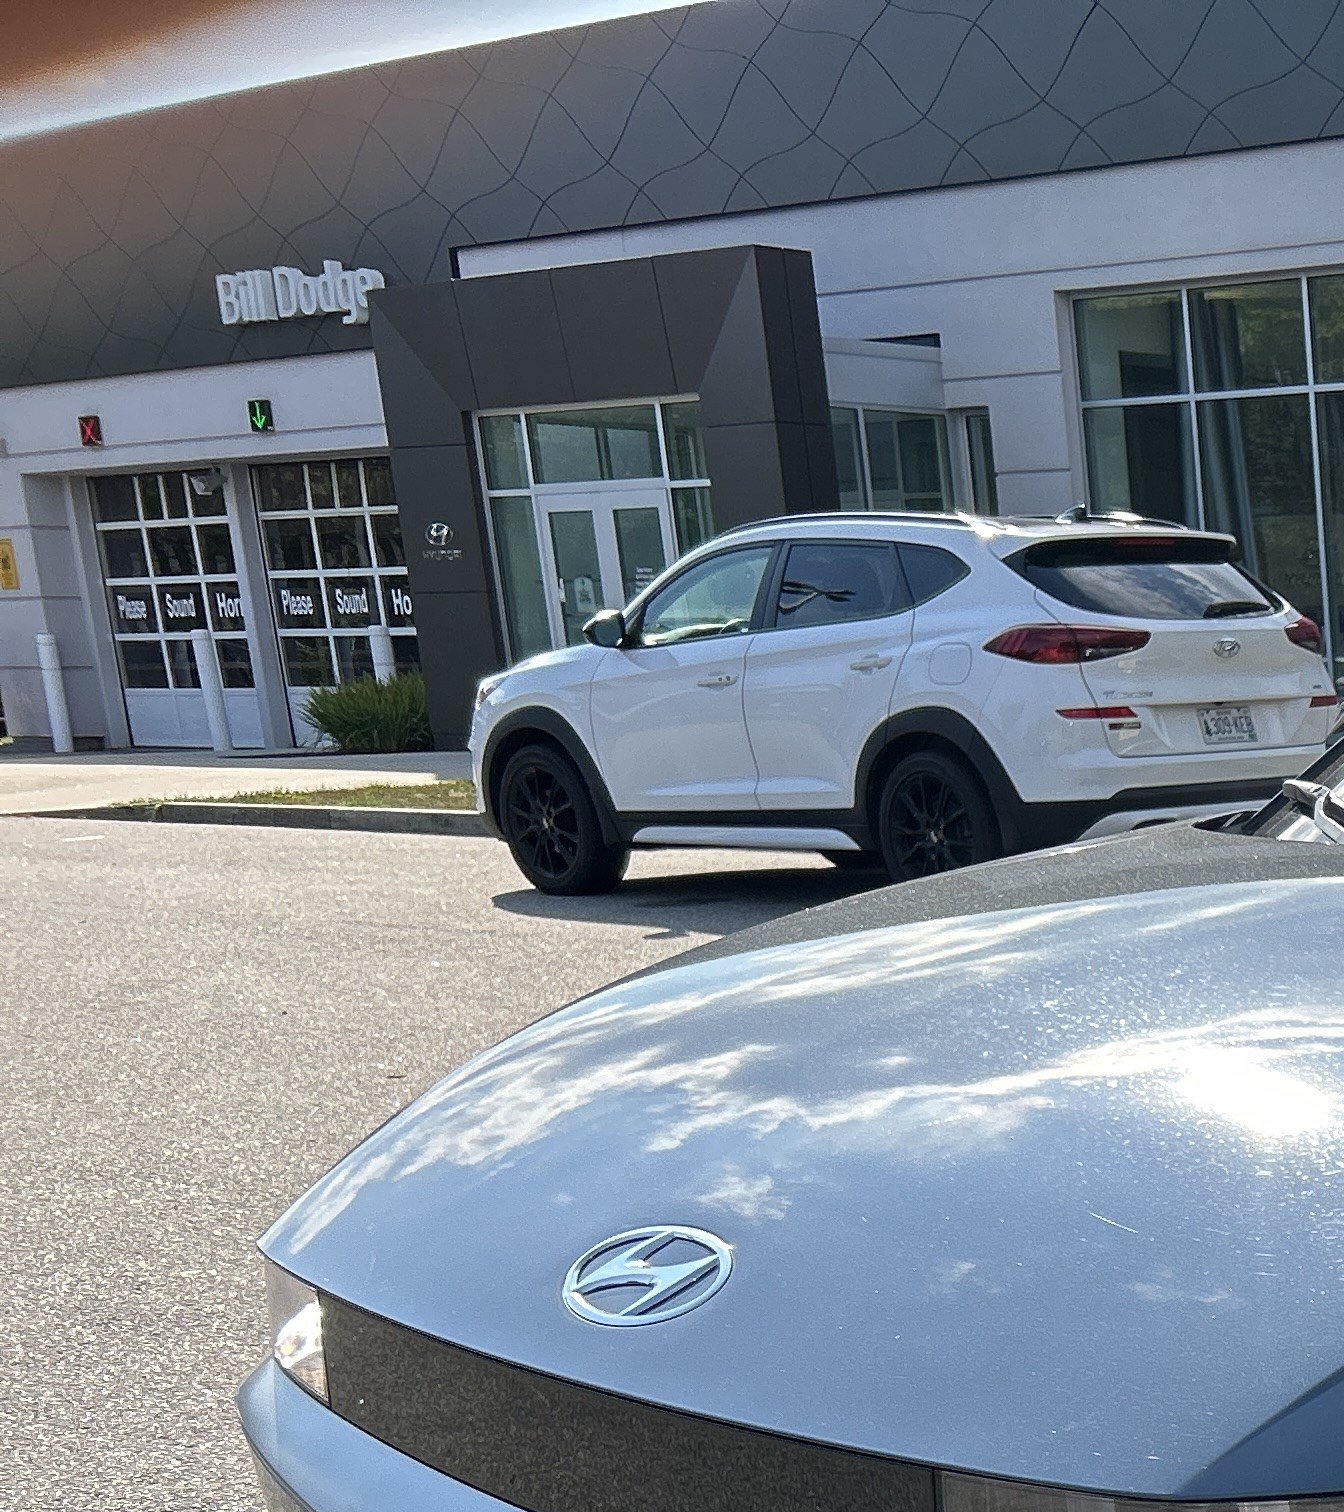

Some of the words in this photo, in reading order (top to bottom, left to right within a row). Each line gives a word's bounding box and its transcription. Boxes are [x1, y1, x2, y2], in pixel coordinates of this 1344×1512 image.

[215, 269, 279, 325] Bill
[272, 260, 384, 324] Dodge
[116, 594, 147, 620] Please
[165, 592, 196, 619] Sound
[280, 588, 314, 616] Please
[335, 587, 369, 615] Sound
[391, 588, 413, 616] Ho
